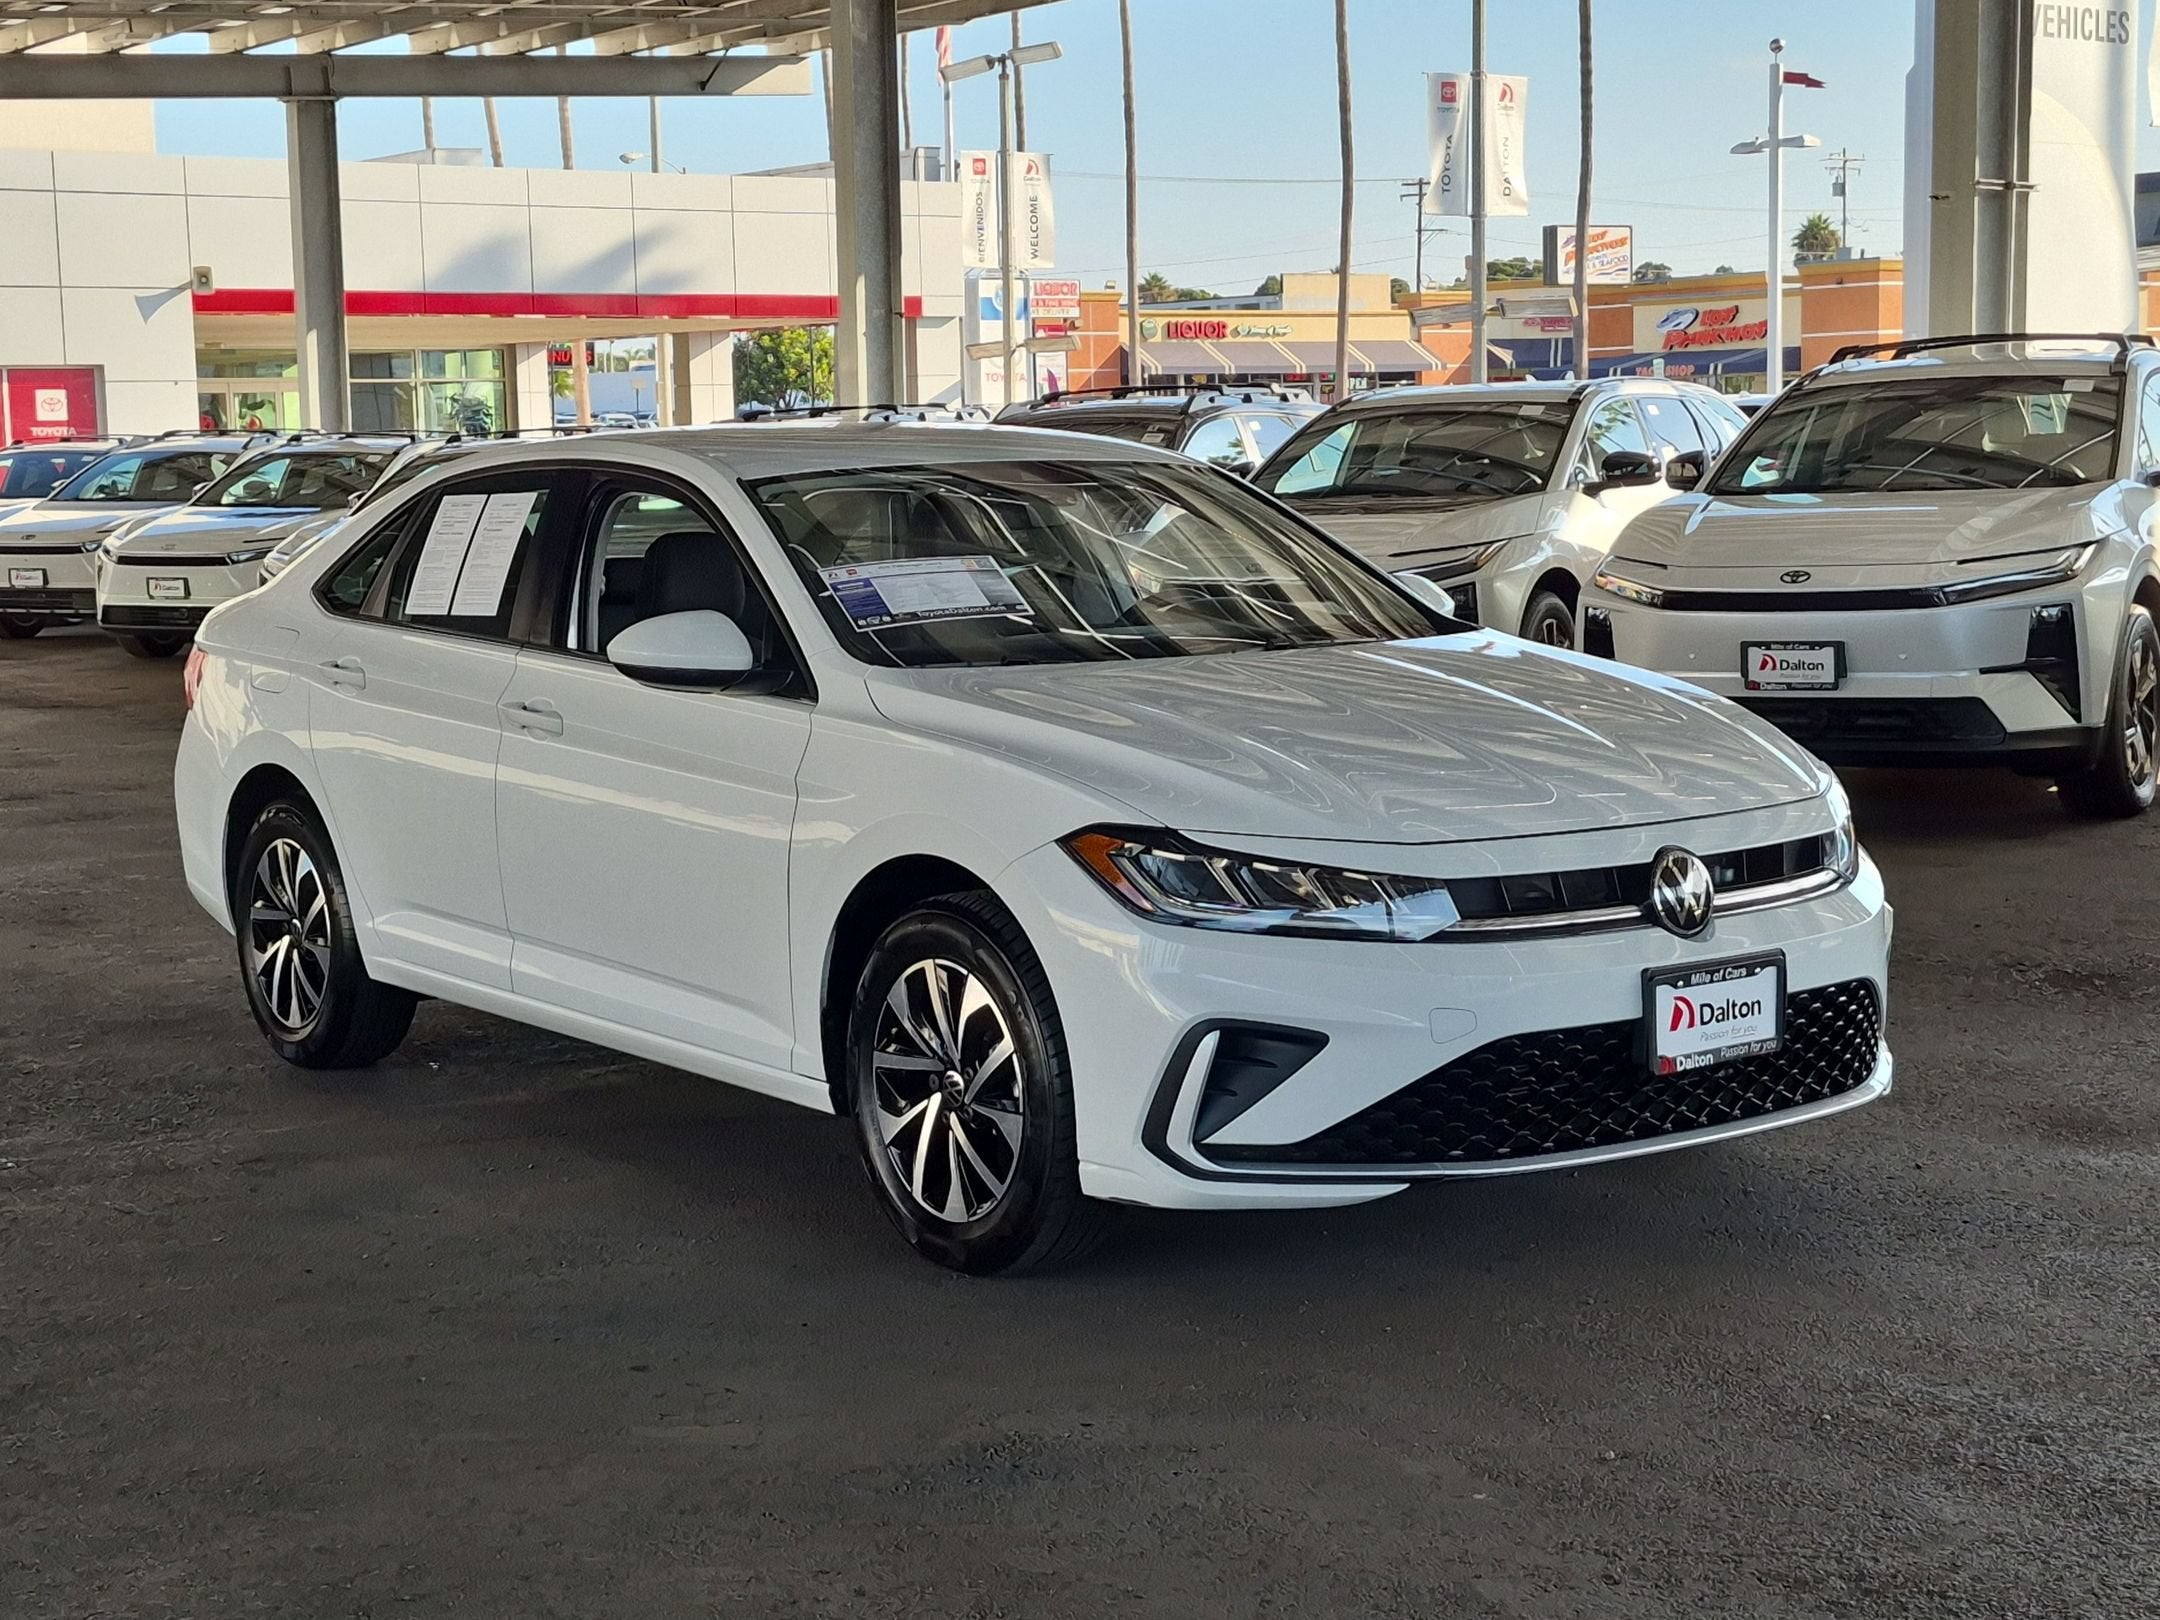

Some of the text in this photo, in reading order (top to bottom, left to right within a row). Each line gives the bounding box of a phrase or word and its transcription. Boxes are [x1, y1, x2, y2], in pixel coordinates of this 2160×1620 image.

[1441, 134, 1453, 195] TOYOTA
[1029, 195, 1040, 260] WELCOME
[1168, 320, 1229, 340] LIQUOR
[985, 372, 1027, 382] TOYTA
[1635, 364, 1696, 377] TAC SHOP
[1349, 377, 1368, 390] PEN
[30, 426, 77, 437] TOYOTA
[917, 604, 1007, 618] ToyotaDalton.com
[1780, 659, 1825, 671] Dalton
[1690, 967, 1747, 985] Mile of Cars
[1700, 998, 1761, 1026] Dalton
[1700, 1024, 1758, 1042] Passion for you
[1676, 1039, 1777, 1072] Dalton Passion for you
